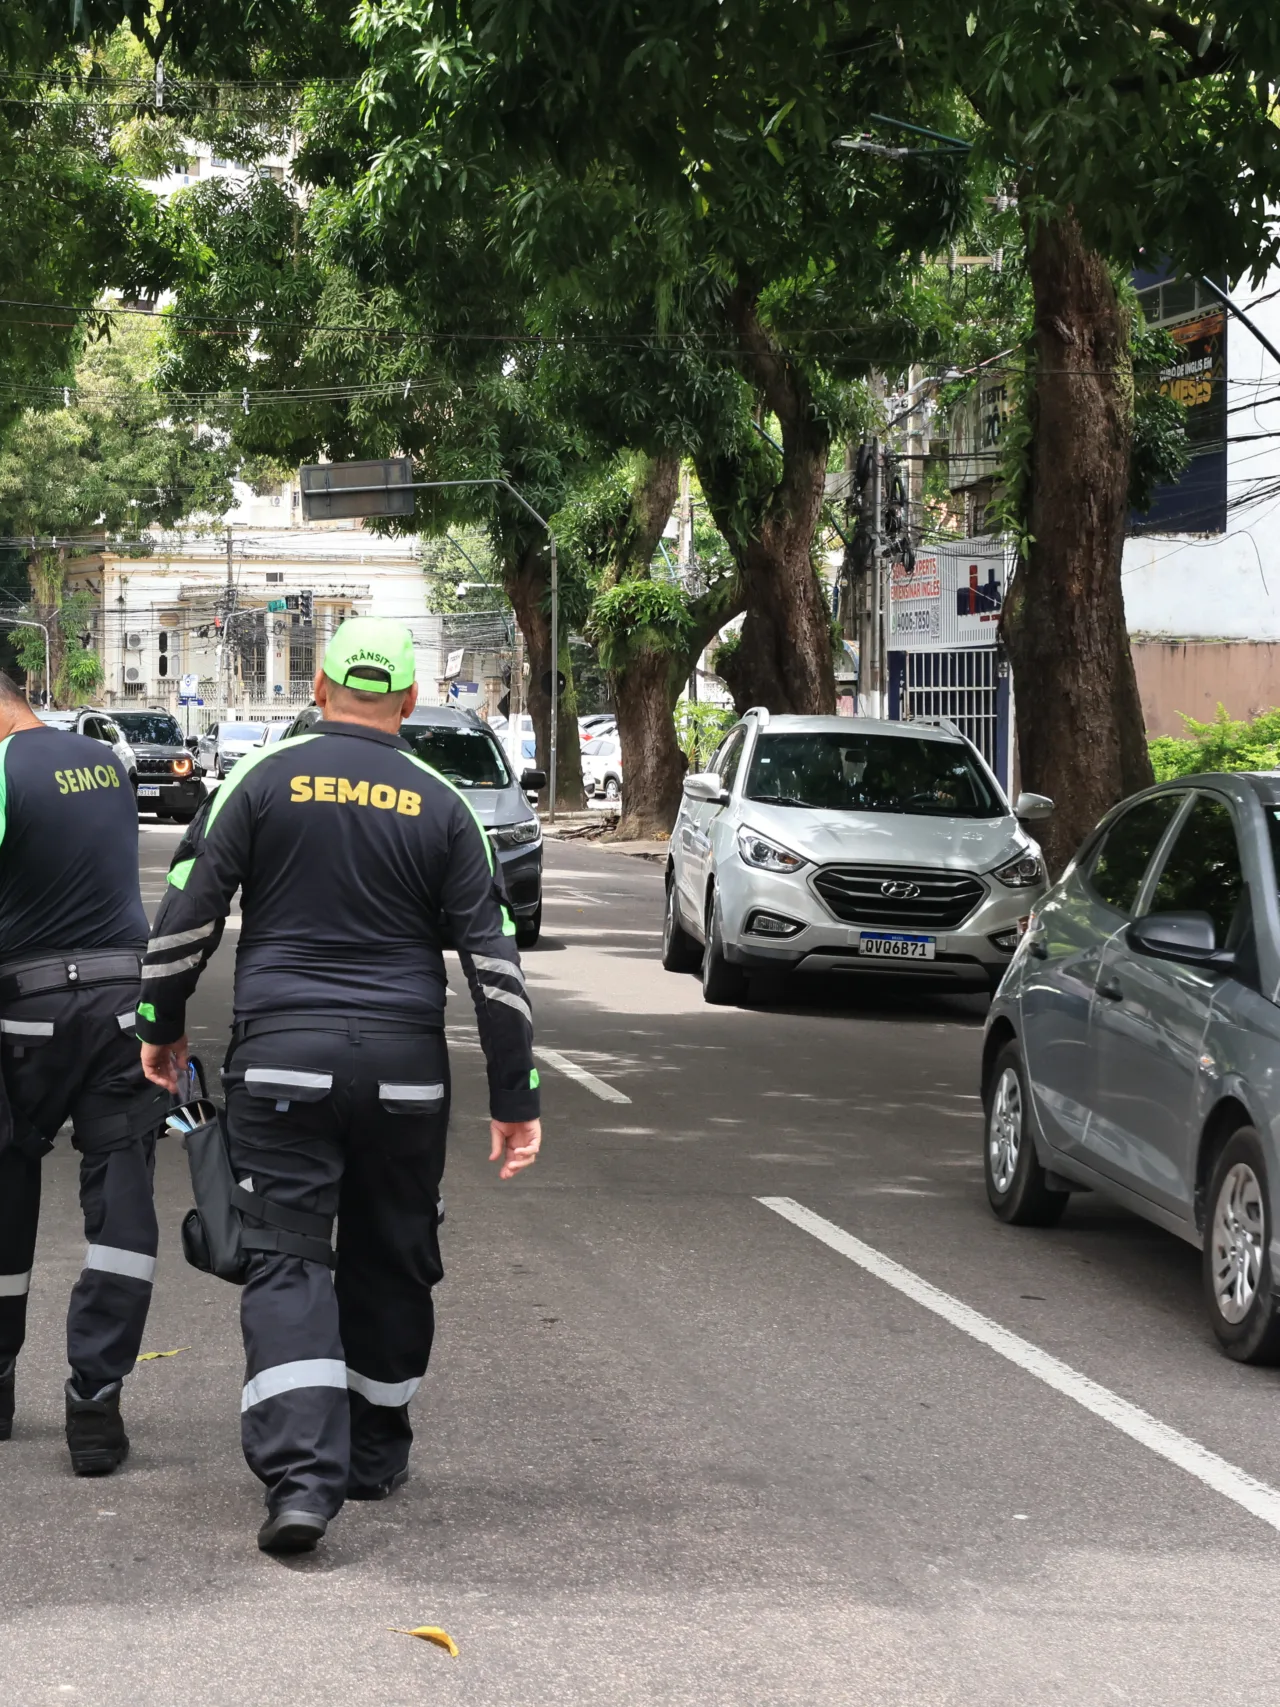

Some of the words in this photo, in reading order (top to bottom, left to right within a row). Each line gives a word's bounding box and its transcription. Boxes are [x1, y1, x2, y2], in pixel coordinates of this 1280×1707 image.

[344, 649, 395, 671] TRÂNSITO
[55, 765, 120, 795] SEMOB
[290, 775, 422, 817] SEMOB
[865, 939, 926, 956] QVQ6B71
